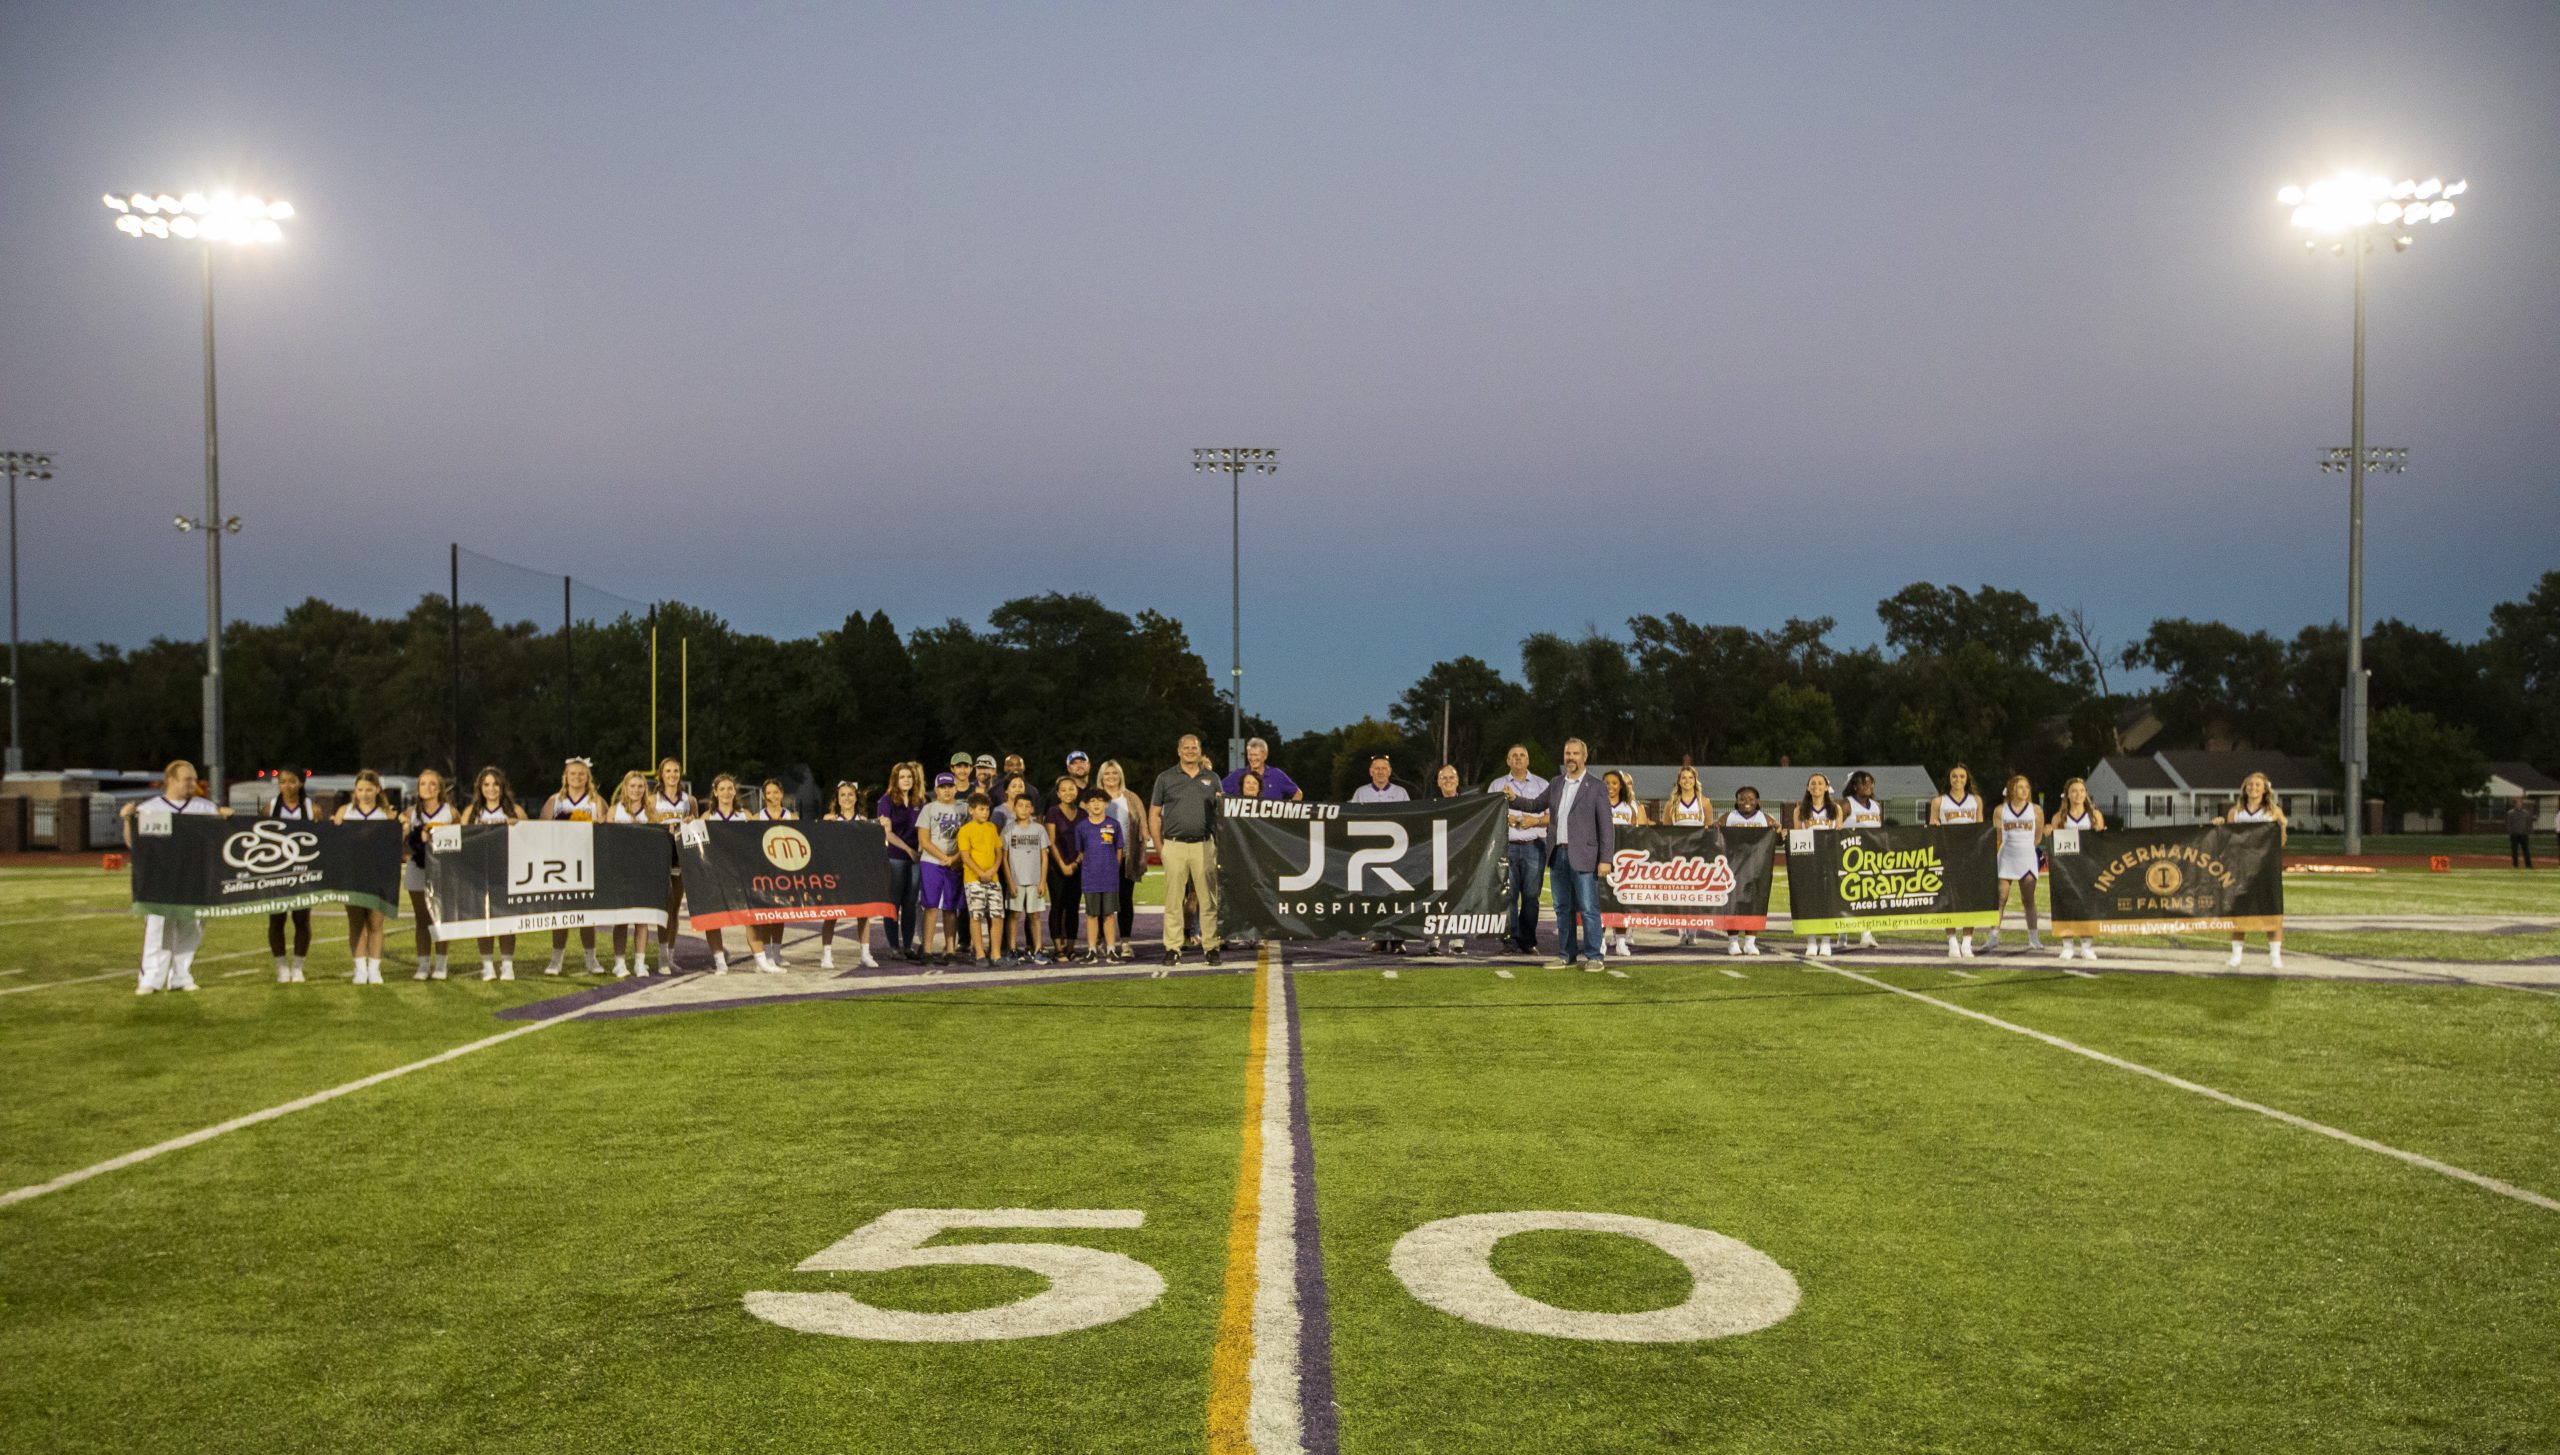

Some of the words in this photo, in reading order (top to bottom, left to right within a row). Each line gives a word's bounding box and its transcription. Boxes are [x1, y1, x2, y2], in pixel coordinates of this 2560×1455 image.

[1224, 798, 1311, 819] WELCOME
[1317, 803, 1340, 819] TO
[436, 838, 458, 847] JRI
[1793, 841, 1811, 850] JRI
[1840, 836, 1862, 850] THE
[2057, 841, 2076, 851] JRI
[1279, 819, 1448, 891] JRI
[1842, 845, 1942, 875] ORIGINAL
[515, 859, 582, 886] JRI
[1611, 853, 1732, 887] Freddy's
[2094, 843, 2236, 893] INGERMANSON
[222, 881, 255, 894] Salina
[257, 876, 297, 890] Country
[299, 871, 323, 884] Club
[752, 873, 837, 892] MOKAS
[508, 892, 595, 905] HOSPITALITY
[1621, 892, 1721, 902] STEAKBURGERS
[1850, 901, 1877, 911] TACOS
[1890, 897, 1934, 908] BURRITOS
[2137, 896, 2194, 909] FARMS
[194, 893, 350, 917] salinacountryclub.com
[1279, 902, 1448, 914] HOSPITALITY
[754, 908, 847, 921] mokasusa.com
[1624, 915, 1714, 927] freddysusa.com
[1423, 914, 1507, 934] STADIUM
[1835, 917, 1952, 931] theoriginalgrande.com
